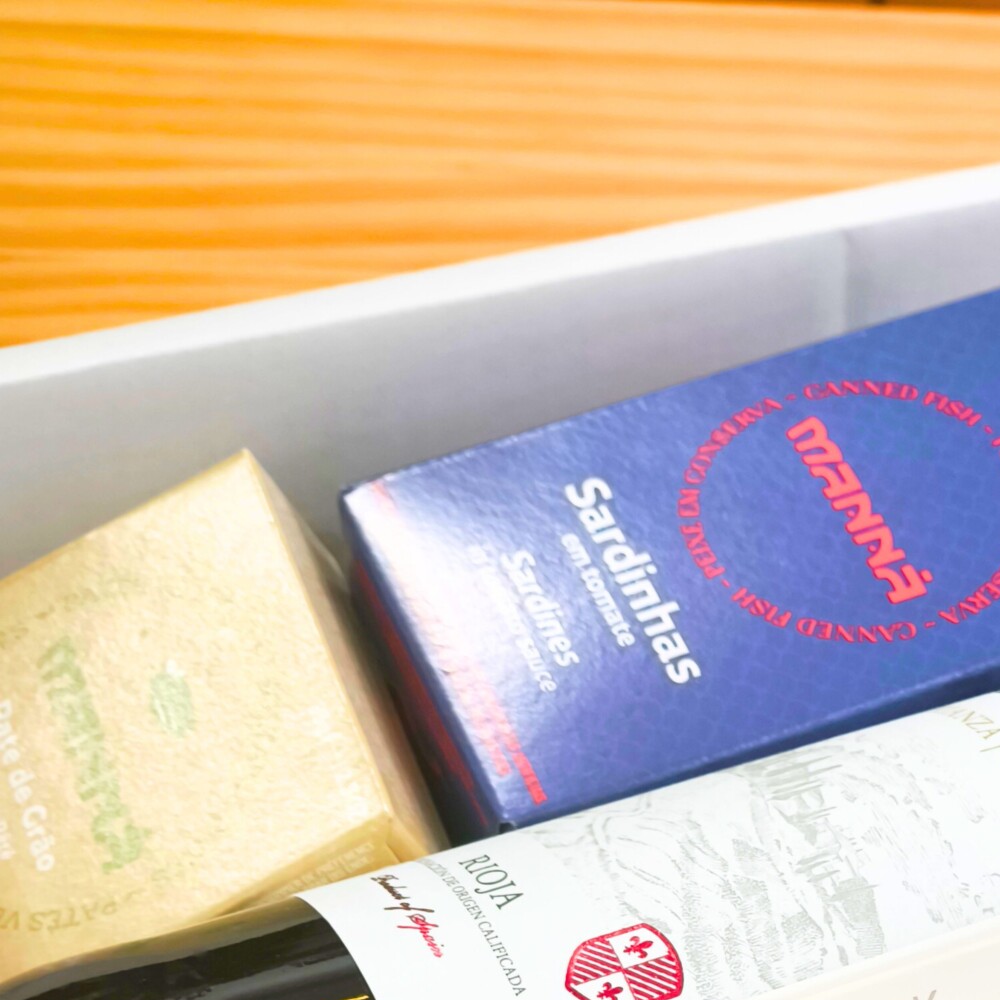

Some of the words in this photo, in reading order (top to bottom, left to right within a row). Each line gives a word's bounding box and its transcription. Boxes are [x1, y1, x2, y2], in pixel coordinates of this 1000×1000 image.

[803, 380, 919, 400] CANNED
[923, 391, 982, 427] FISH
[500, 550, 580, 667] Sardines
[561, 533, 591, 569] em
[581, 567, 635, 647] tomate
[564, 477, 701, 684] Sardinhas
[732, 588, 792, 628] FISH
[797, 618, 917, 643] CANNED
[459, 854, 524, 909] RIOJA
[442, 874, 457, 887] DE
[452, 883, 486, 923] ORIGEN
[478, 918, 526, 996] CALIFICADA
